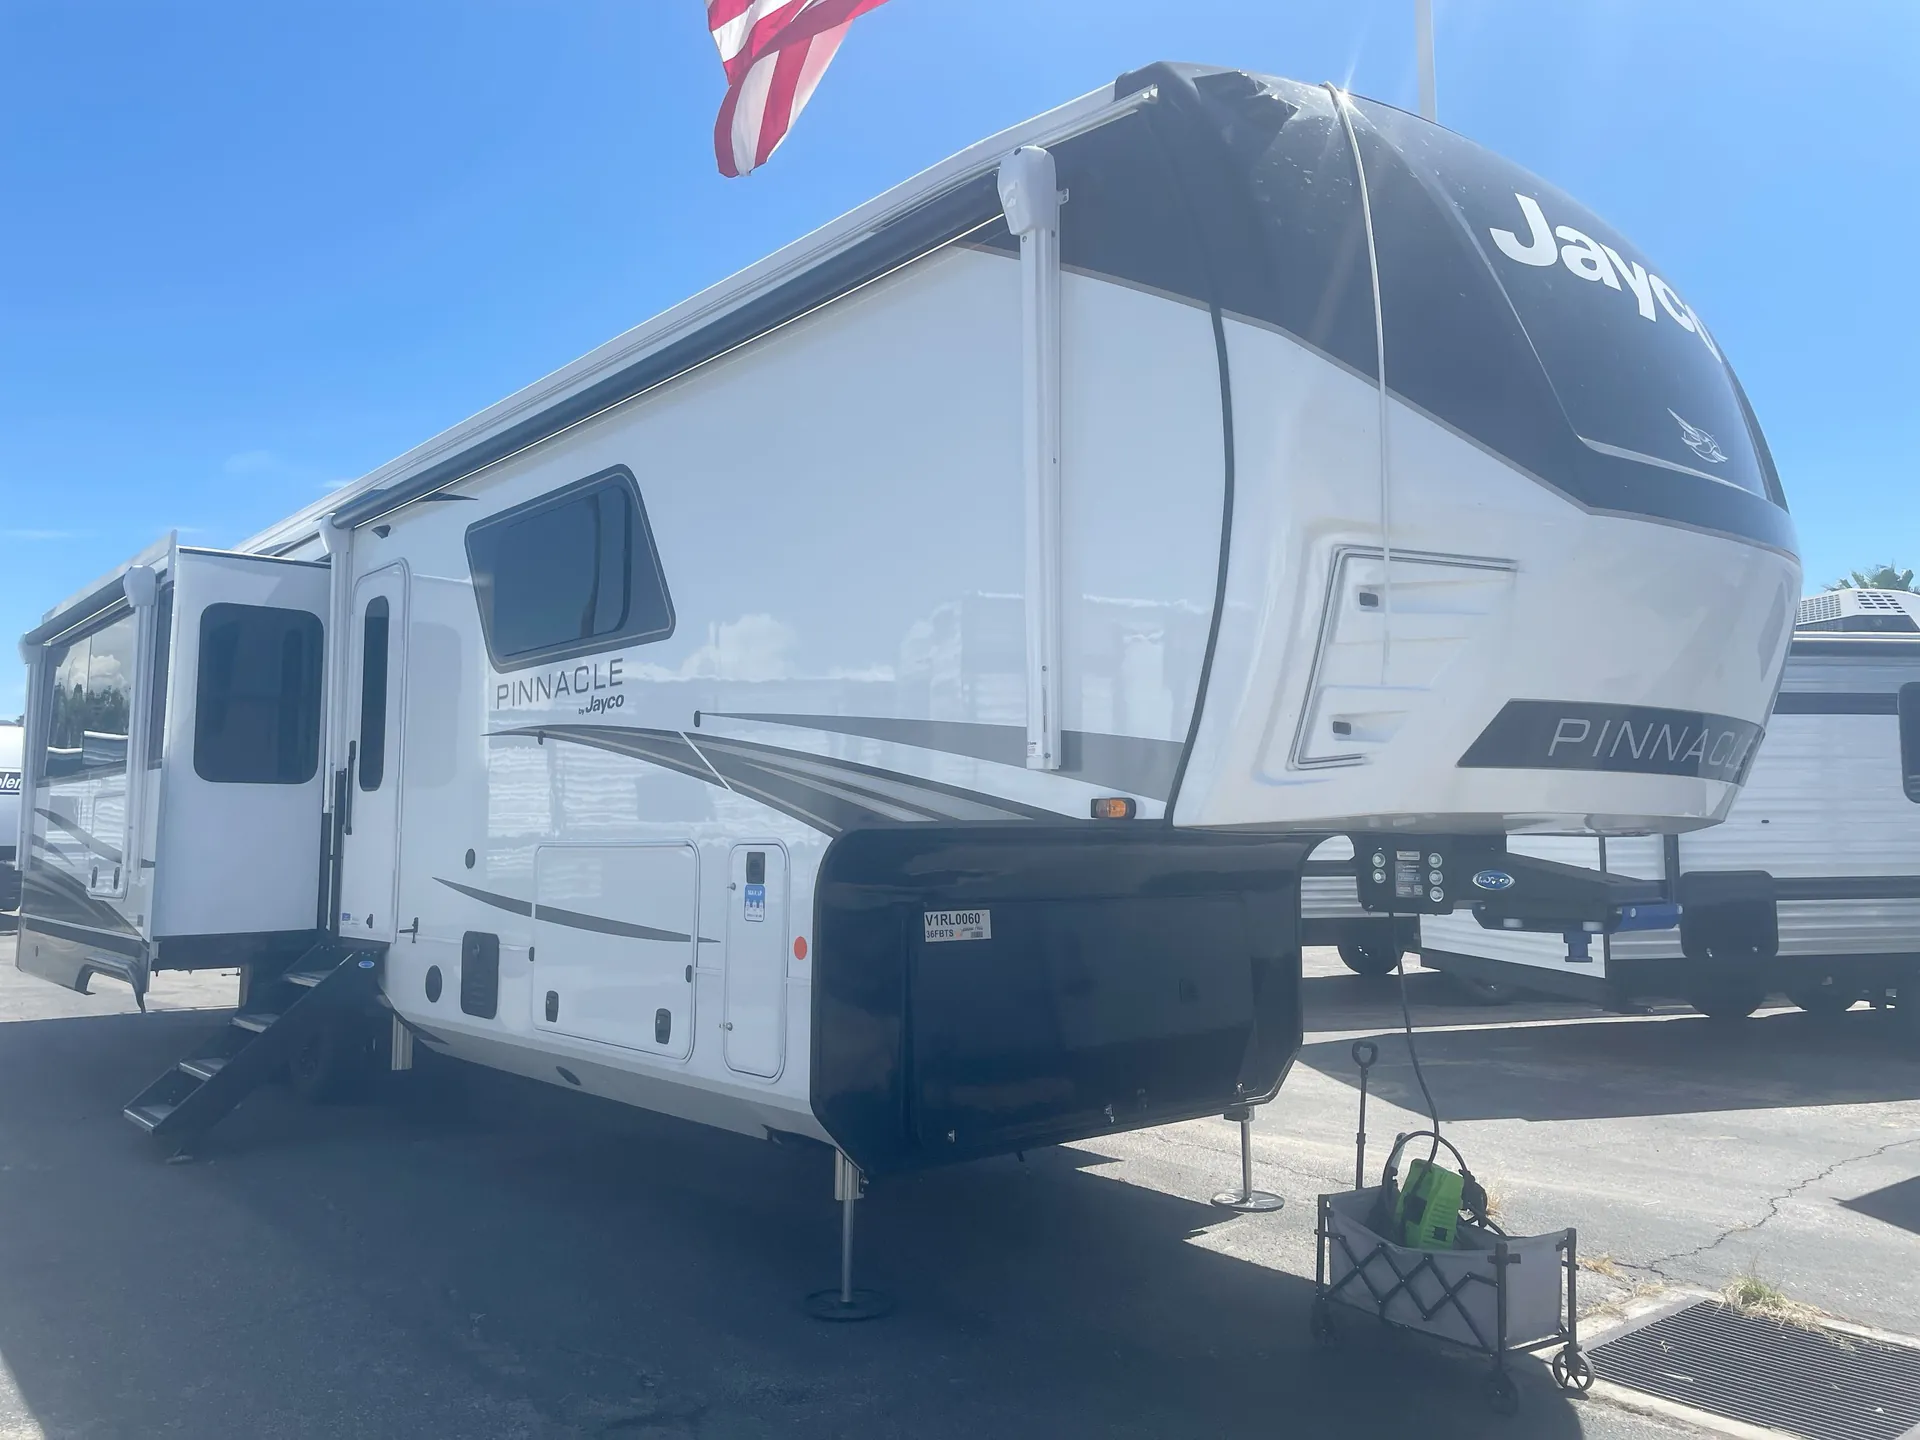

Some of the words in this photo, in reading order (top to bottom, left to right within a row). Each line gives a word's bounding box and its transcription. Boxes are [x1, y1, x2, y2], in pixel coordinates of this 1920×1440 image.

[496, 657, 624, 710] PINNACLE
[578, 707, 585, 715] by
[585, 694, 625, 715] Jayco
[1548, 718, 1752, 769] PINNACL
[925, 912, 981, 926] V1RL0060
[926, 929, 954, 939] 36FBTS
